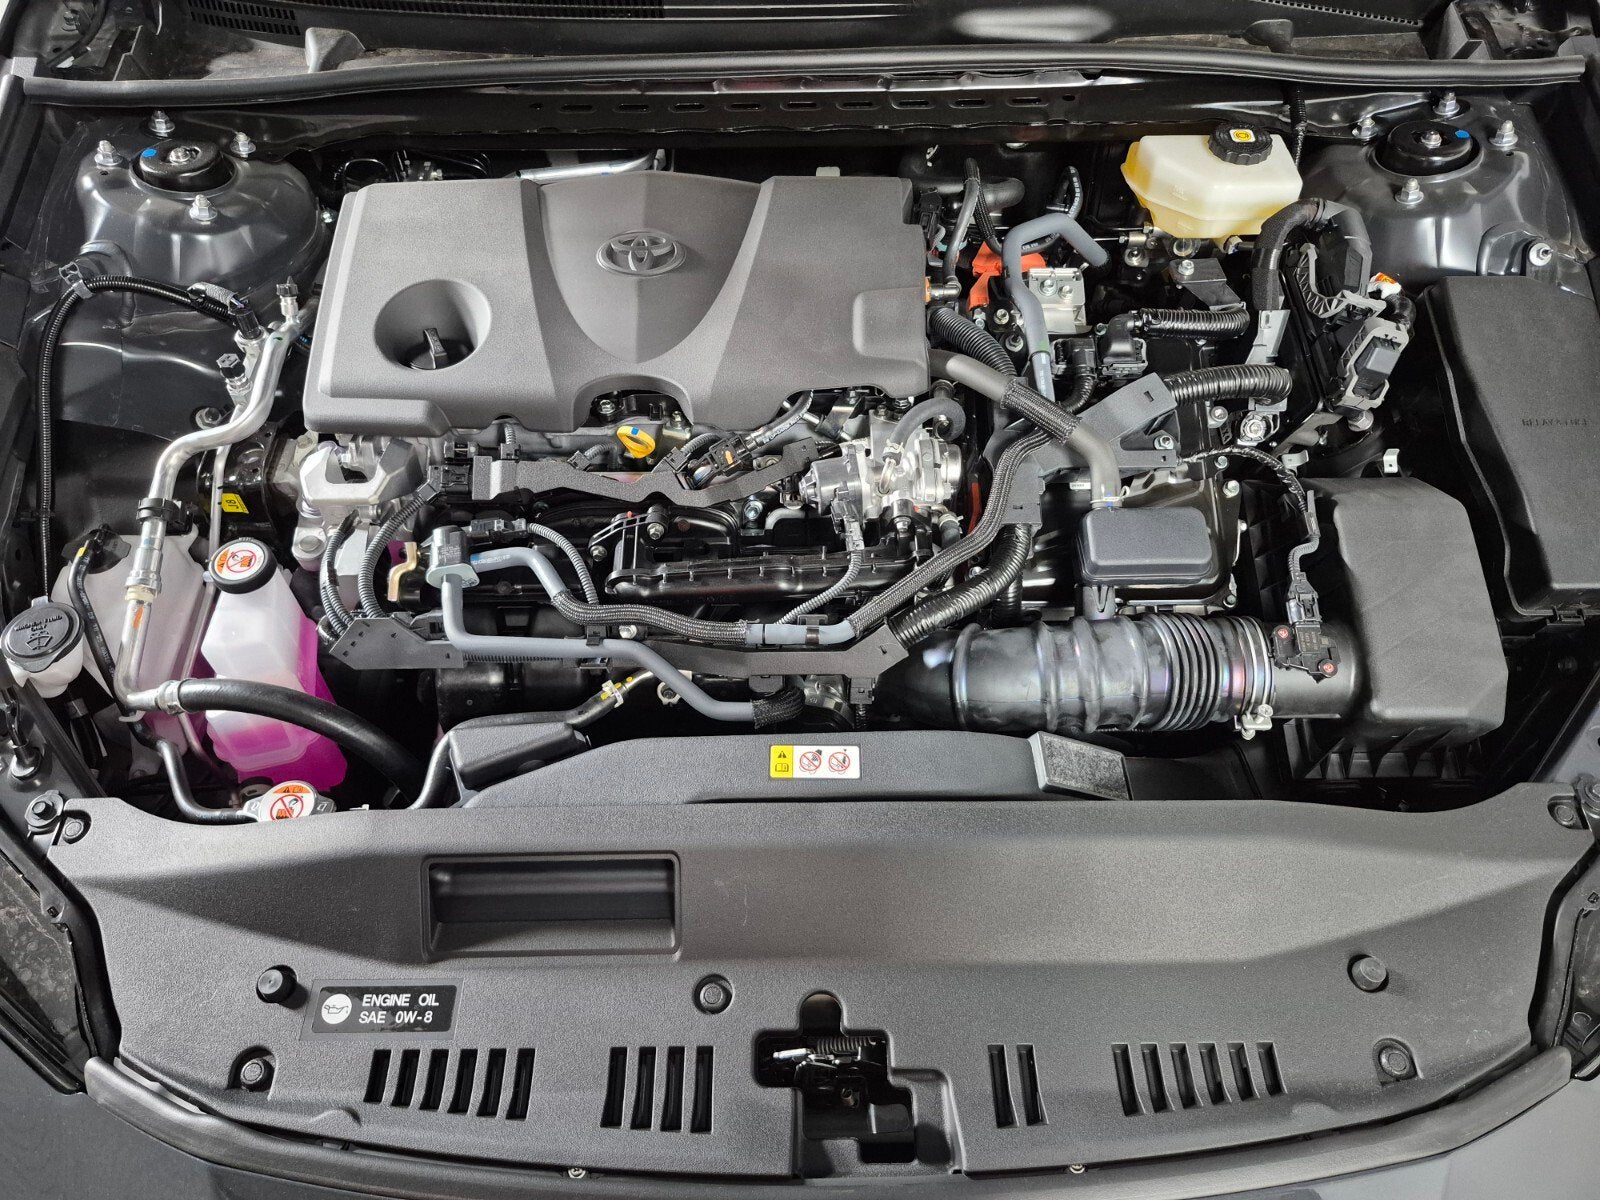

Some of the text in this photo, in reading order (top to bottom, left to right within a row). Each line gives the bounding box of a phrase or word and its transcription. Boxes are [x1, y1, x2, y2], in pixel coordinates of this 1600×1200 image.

[362, 993, 440, 1007] ENGINE OIL
[358, 1010, 433, 1024] SAE 0W-8
